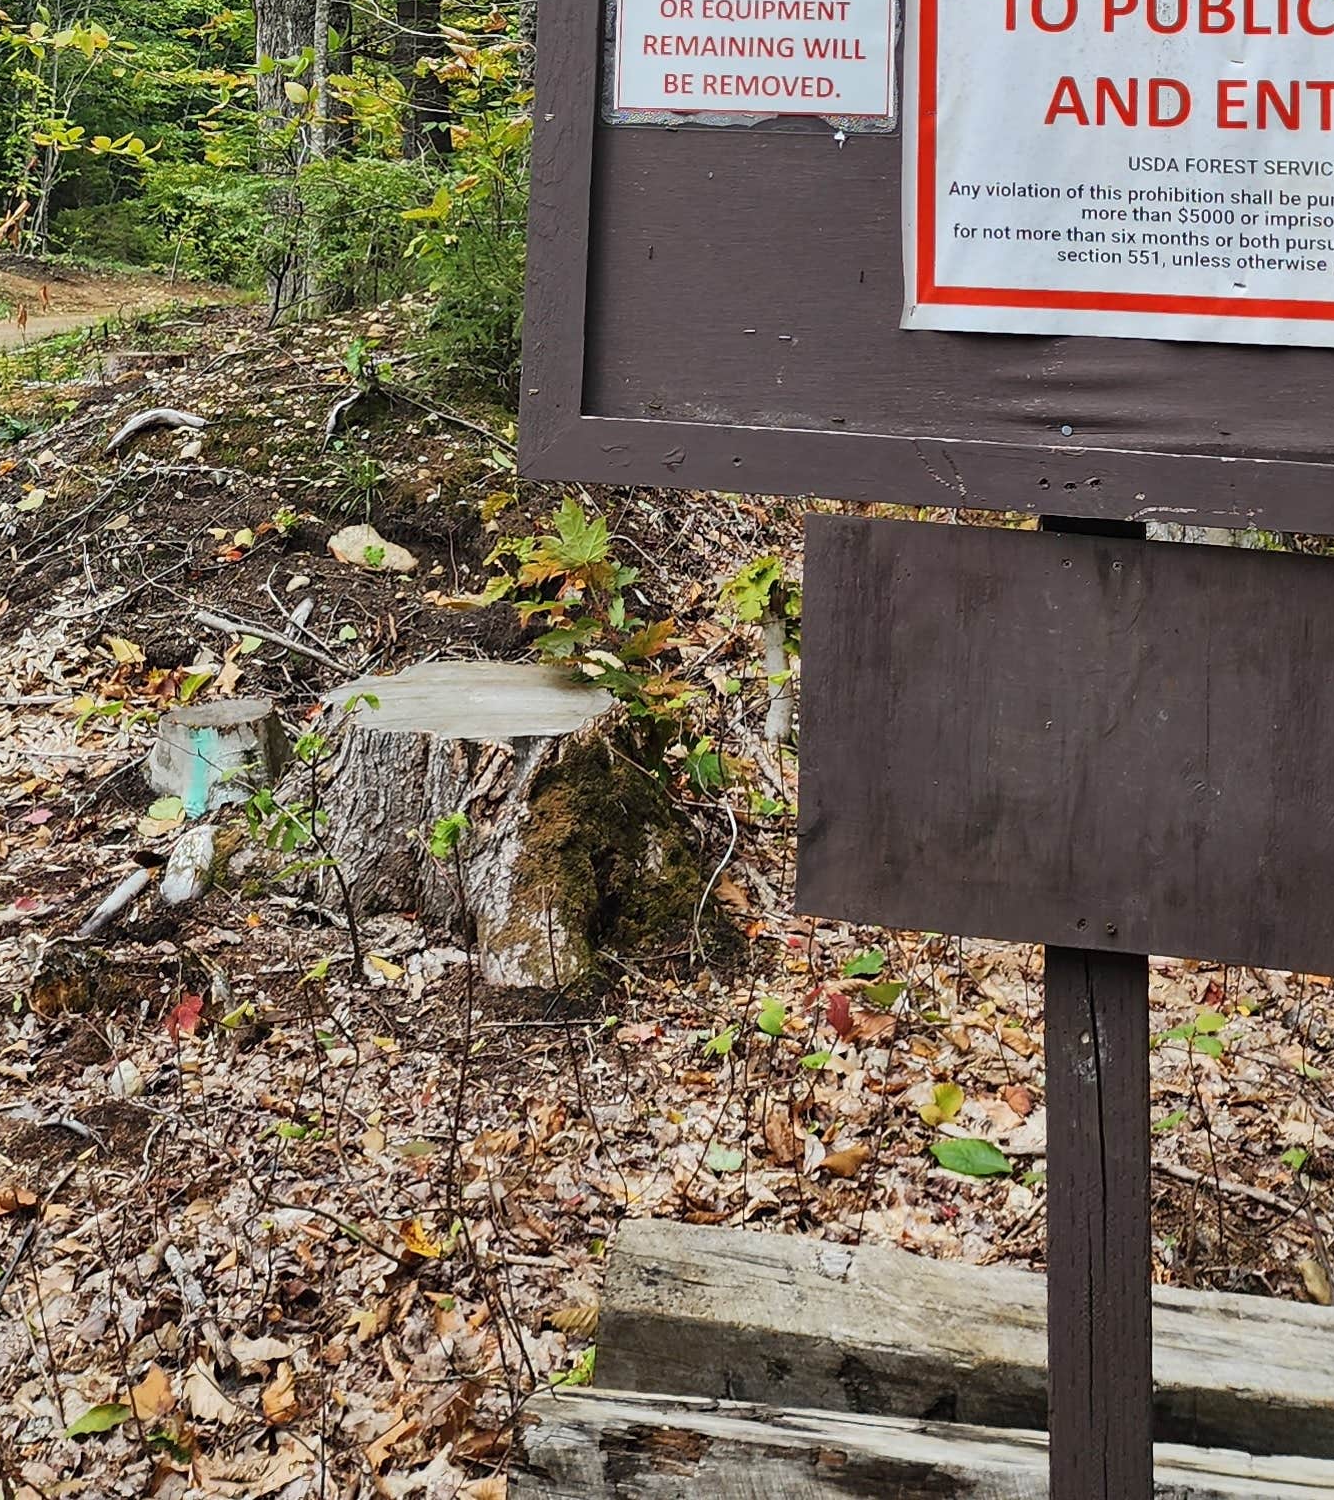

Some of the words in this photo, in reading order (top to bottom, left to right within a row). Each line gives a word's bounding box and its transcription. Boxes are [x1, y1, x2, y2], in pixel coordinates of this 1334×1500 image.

[661, 0, 693, 18] OR
[703, 0, 850, 21] EQUIPMENT
[644, 35, 794, 58] REMAINING
[804, 38, 866, 59] WILL
[665, 74, 693, 94] BE
[703, 75, 840, 98] REMOVED.
[1045, 76, 1191, 127] AND
[1129, 156, 1179, 172] USDA
[1186, 158, 1258, 174] FOREST
[949, 181, 980, 199] Any
[986, 182, 1060, 198] violation
[1067, 184, 1084, 198] of
[1090, 185, 1122, 200] this
[1129, 186, 1224, 204] prohibition
[1231, 189, 1272, 204] shall
[1280, 190, 1301, 205] be
[1082, 209, 1127, 220] more
[1132, 206, 1171, 222] than
[1178, 206, 1234, 224] $5000
[1241, 214, 1259, 225] or
[954, 223, 977, 238] for
[984, 227, 1011, 239] not
[1017, 229, 1061, 241] more
[1066, 227, 1105, 242] than
[1112, 229, 1136, 244] six
[1143, 231, 1209, 246] months
[1216, 236, 1233, 247] or
[1240, 233, 1279, 248] both
[1058, 249, 1121, 263] section
[1128, 250, 1165, 268] 551,
[1173, 252, 1230, 268] unless
[1237, 254, 1327, 271] otherwise
